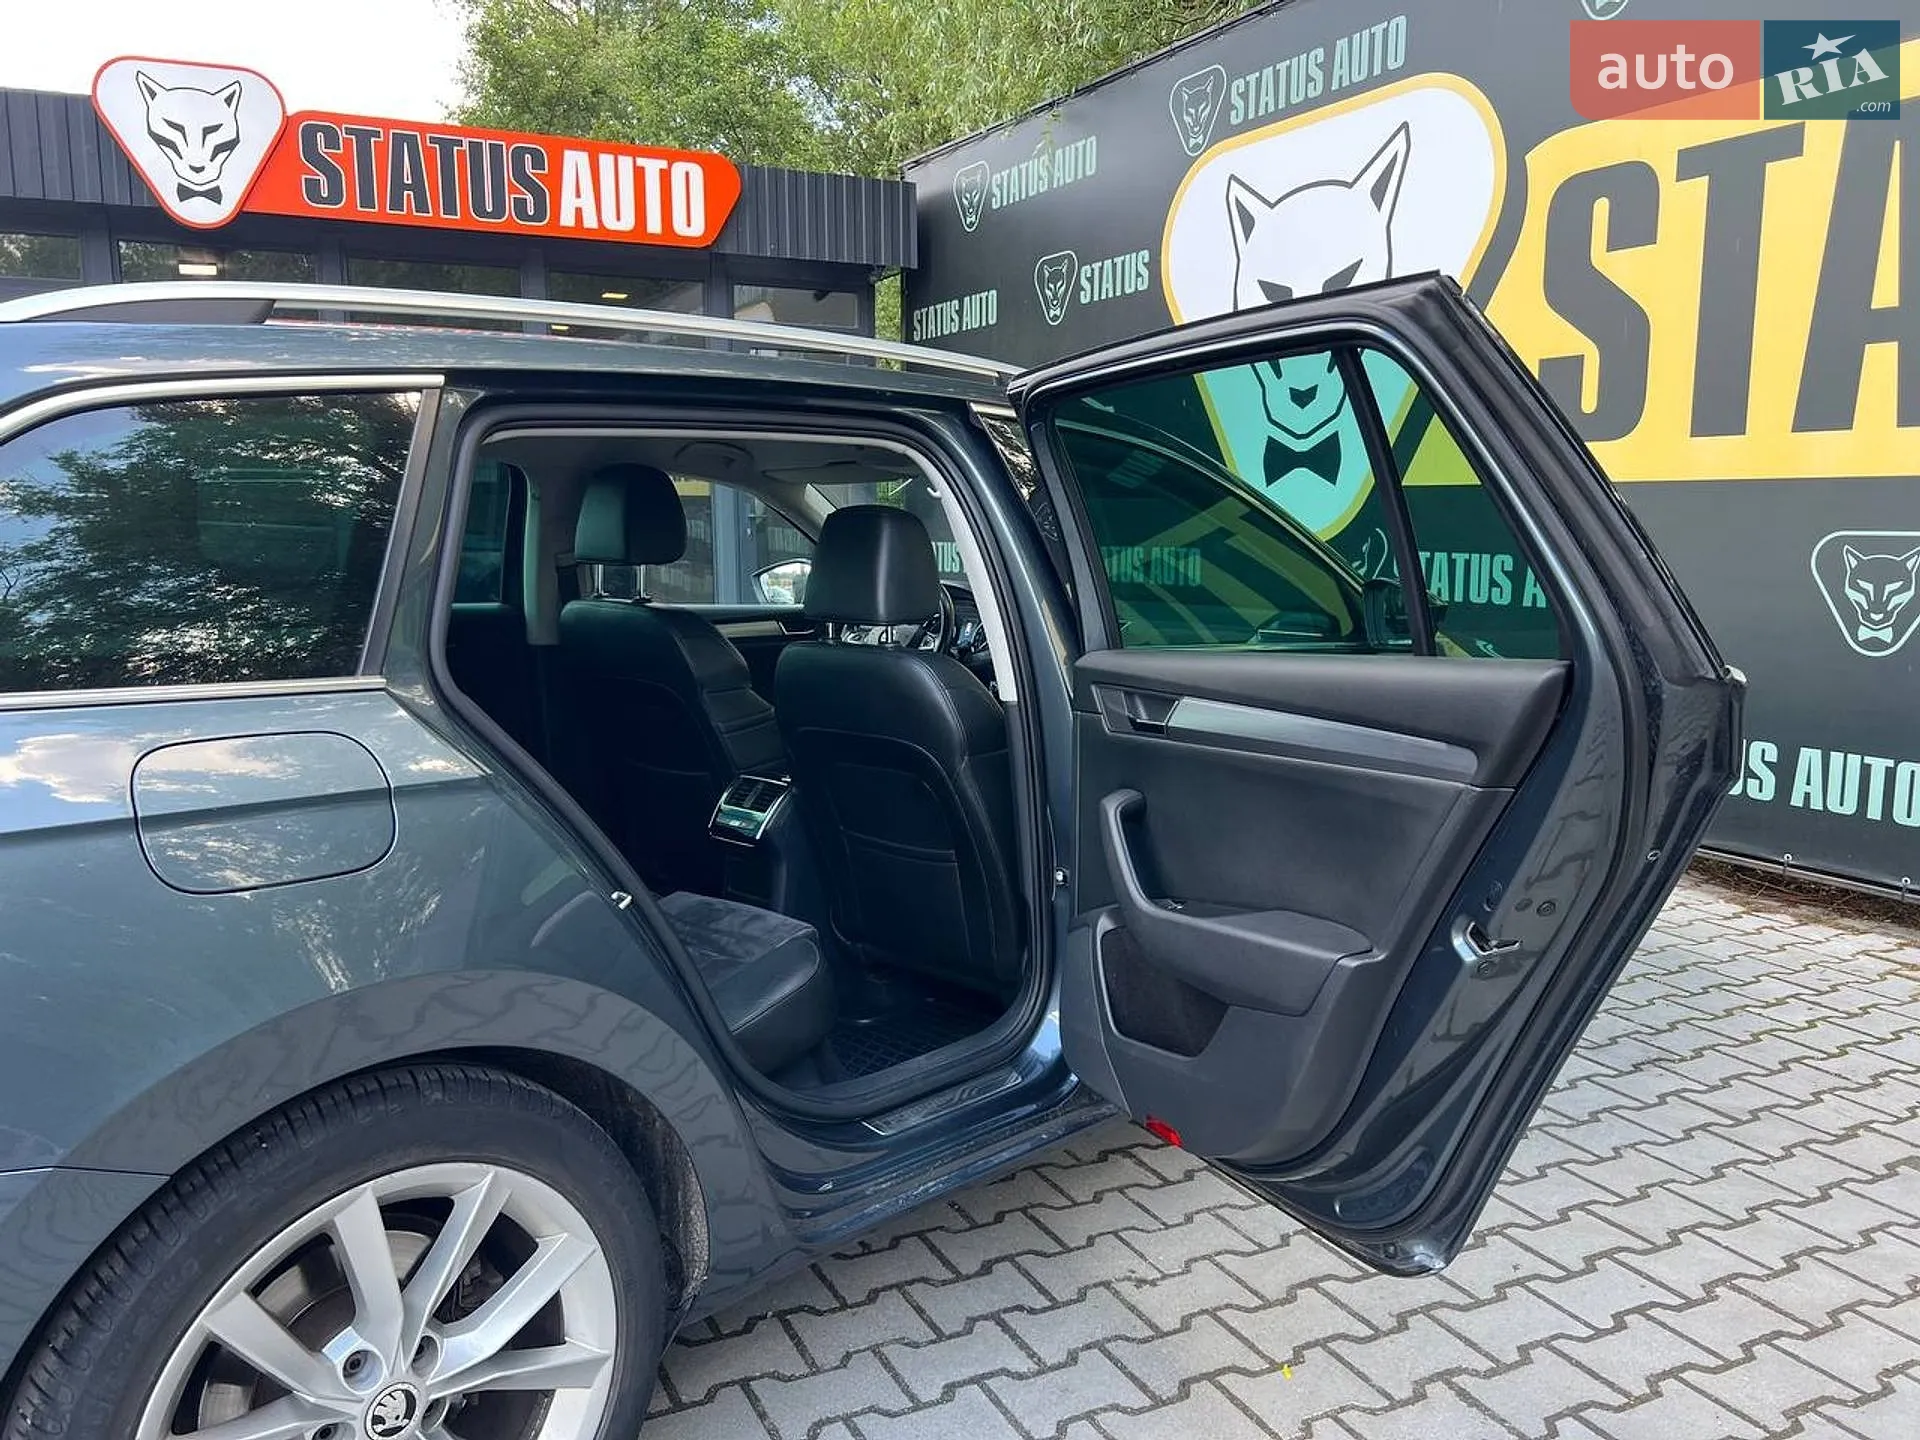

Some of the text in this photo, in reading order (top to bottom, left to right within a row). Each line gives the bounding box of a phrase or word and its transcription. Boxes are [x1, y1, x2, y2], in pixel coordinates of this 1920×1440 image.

[1230, 15, 1407, 126] STATUS AUTO
[300, 120, 705, 238] STATUS AUTO
[991, 135, 1097, 210] STATUS AUTO
[1079, 249, 1150, 304] STATUS
[913, 289, 998, 342] STATUS AUTO
[1151, 546, 1202, 587] AUTO
[1789, 747, 1920, 828] AUTO
